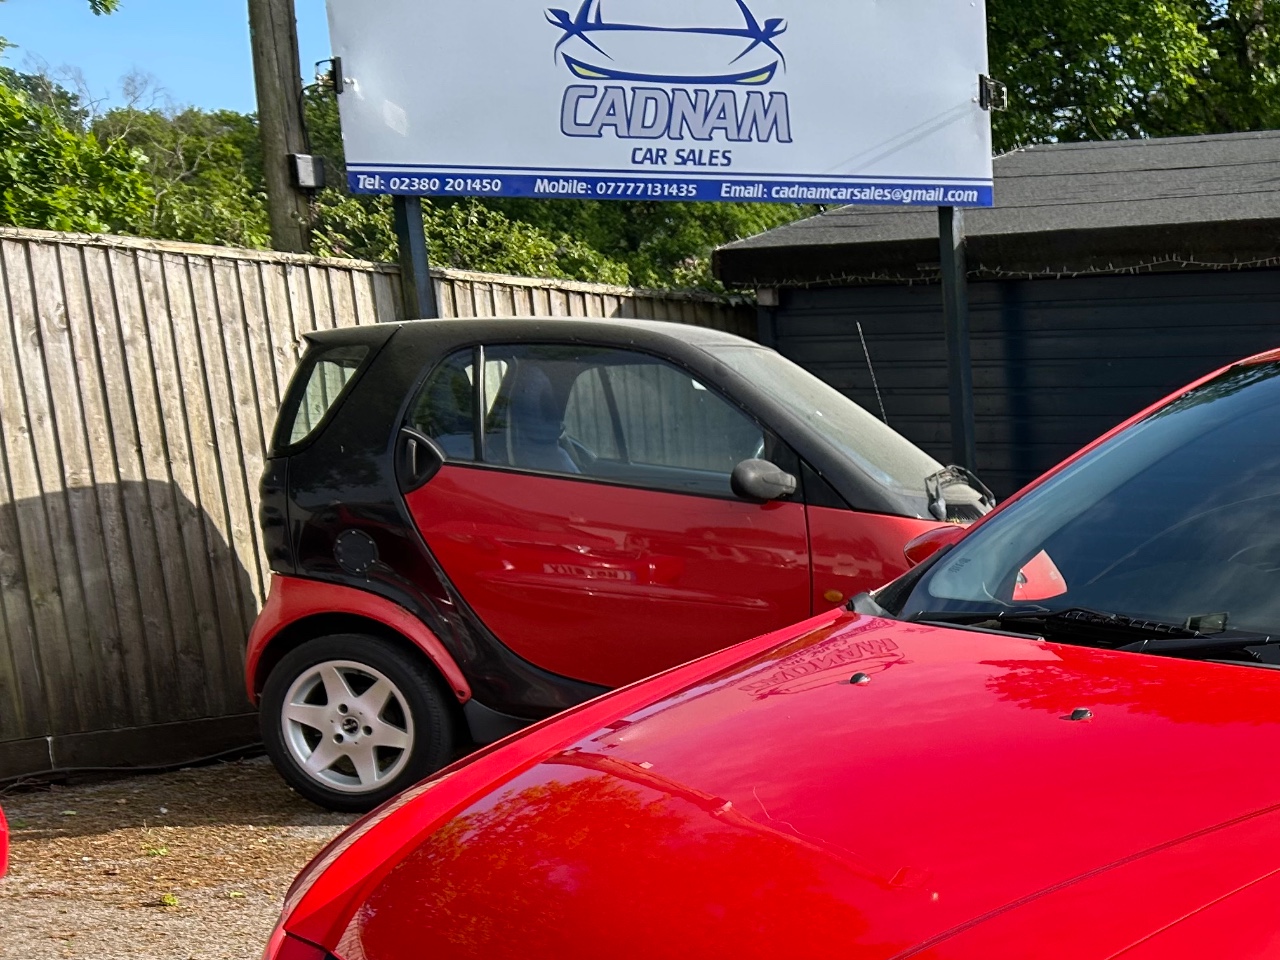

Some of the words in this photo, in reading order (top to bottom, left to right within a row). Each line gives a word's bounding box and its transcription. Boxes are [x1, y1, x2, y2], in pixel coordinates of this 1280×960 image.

[560, 84, 793, 143] CADNAM
[631, 147, 668, 165] CAR
[674, 149, 732, 166] SALES
[356, 174, 385, 190] Tel:
[389, 177, 439, 191] 02380
[445, 178, 502, 193] 201450
[534, 178, 592, 195] Mobile:
[596, 181, 697, 197] 07777131435
[720, 183, 768, 199] Email:
[771, 184, 978, 203] cadnamcarsales@gmail.com
